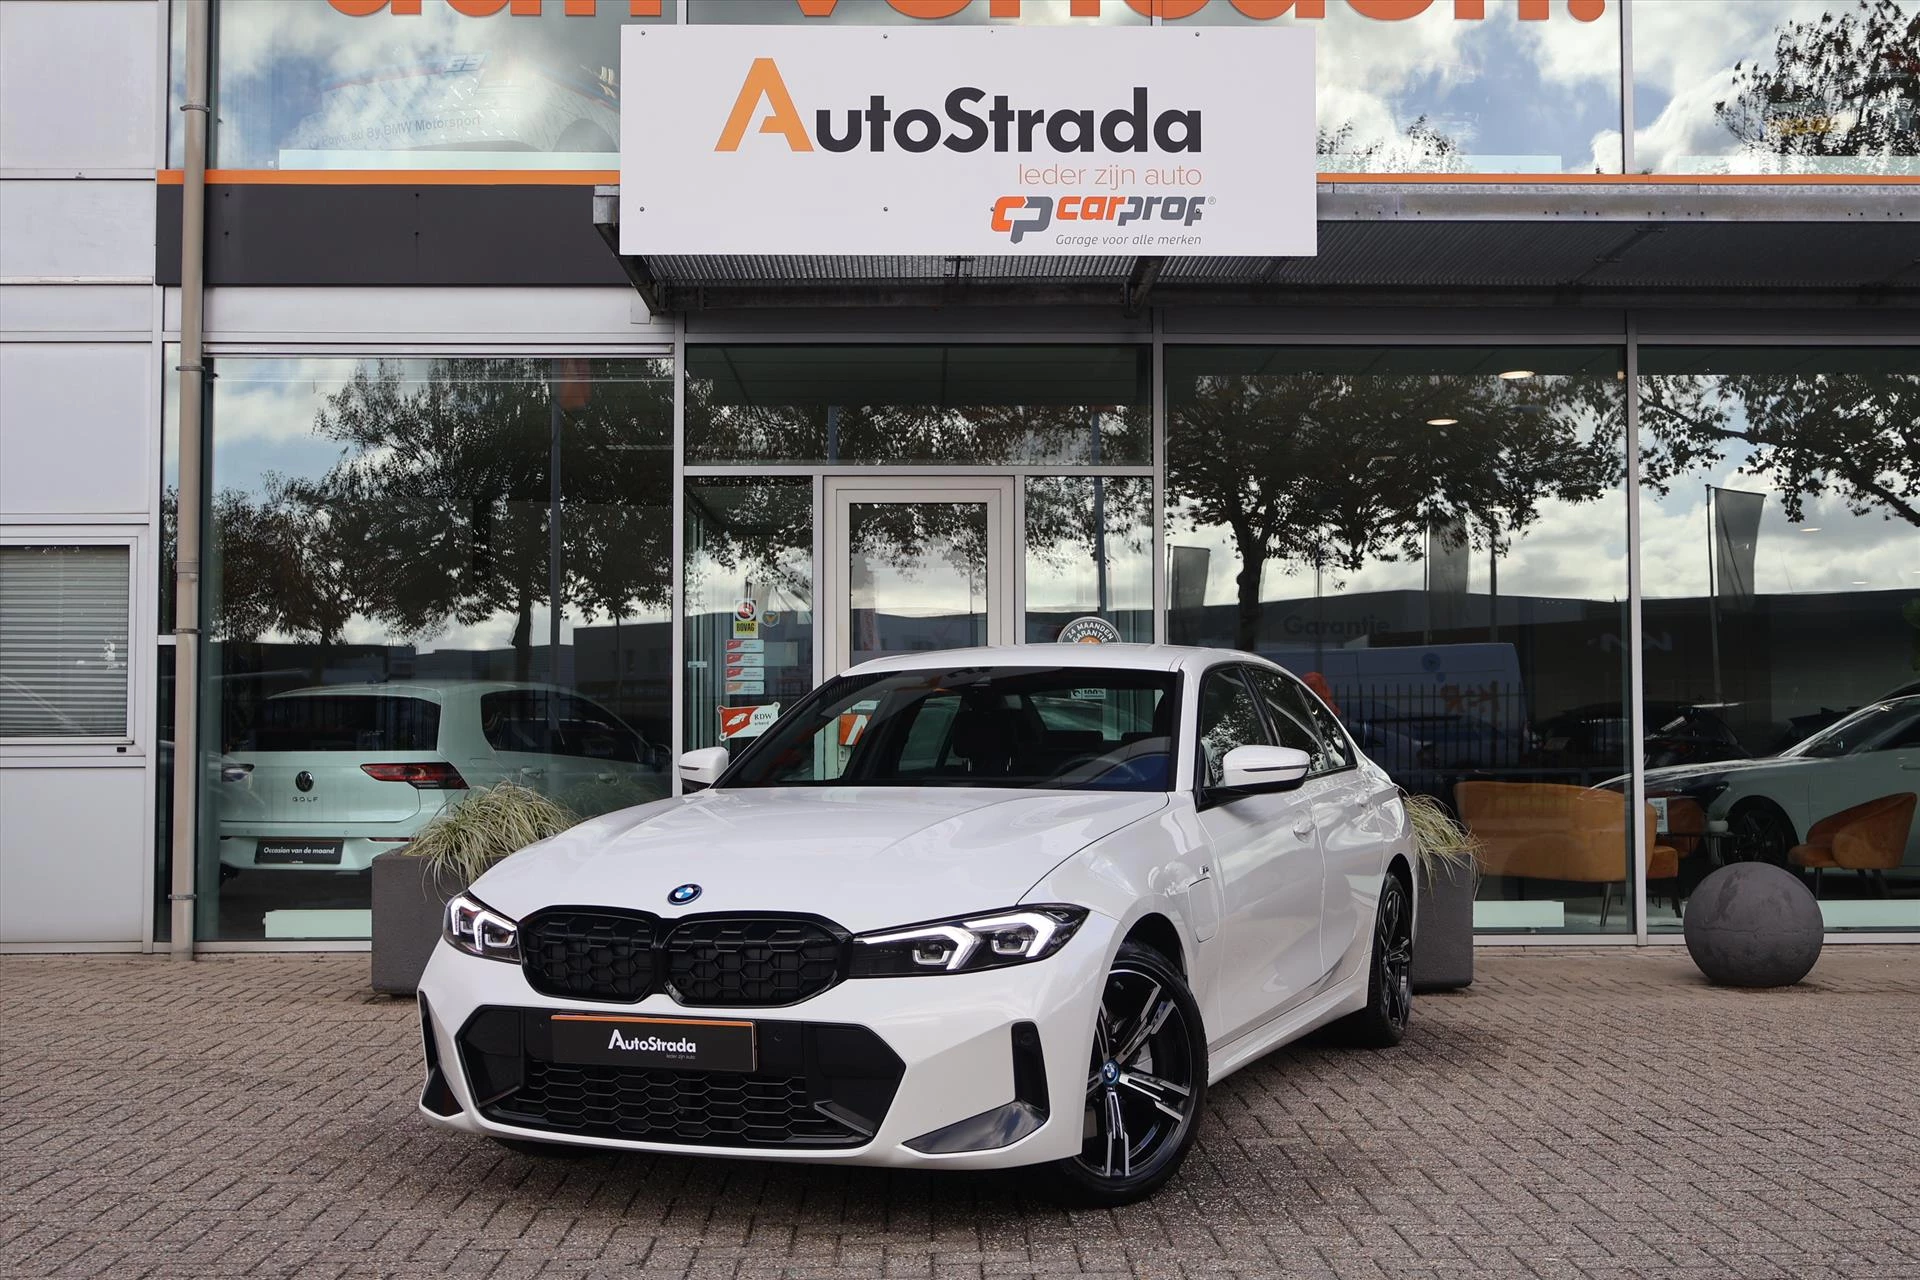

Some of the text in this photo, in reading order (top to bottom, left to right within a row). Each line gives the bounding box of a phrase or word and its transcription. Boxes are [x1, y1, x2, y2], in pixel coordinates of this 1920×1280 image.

[714, 57, 1202, 154] AutoStrada
[383, 121, 412, 137] BMW
[414, 115, 482, 131] Motorsport
[1019, 163, 1203, 191] Ieder zijn auto
[1056, 234, 1202, 246] Garage voor alle merken
[736, 622, 755, 632] BOVAG
[1067, 622, 1115, 640] 24 MAANDEN
[1283, 614, 1391, 635] Garantie
[1072, 629, 1109, 644] GARANTIE
[754, 712, 773, 720] RDW
[263, 846, 291, 854] Occasion
[303, 846, 312, 854] de
[312, 846, 336, 855] maand
[608, 1029, 697, 1053] AutoStrada
